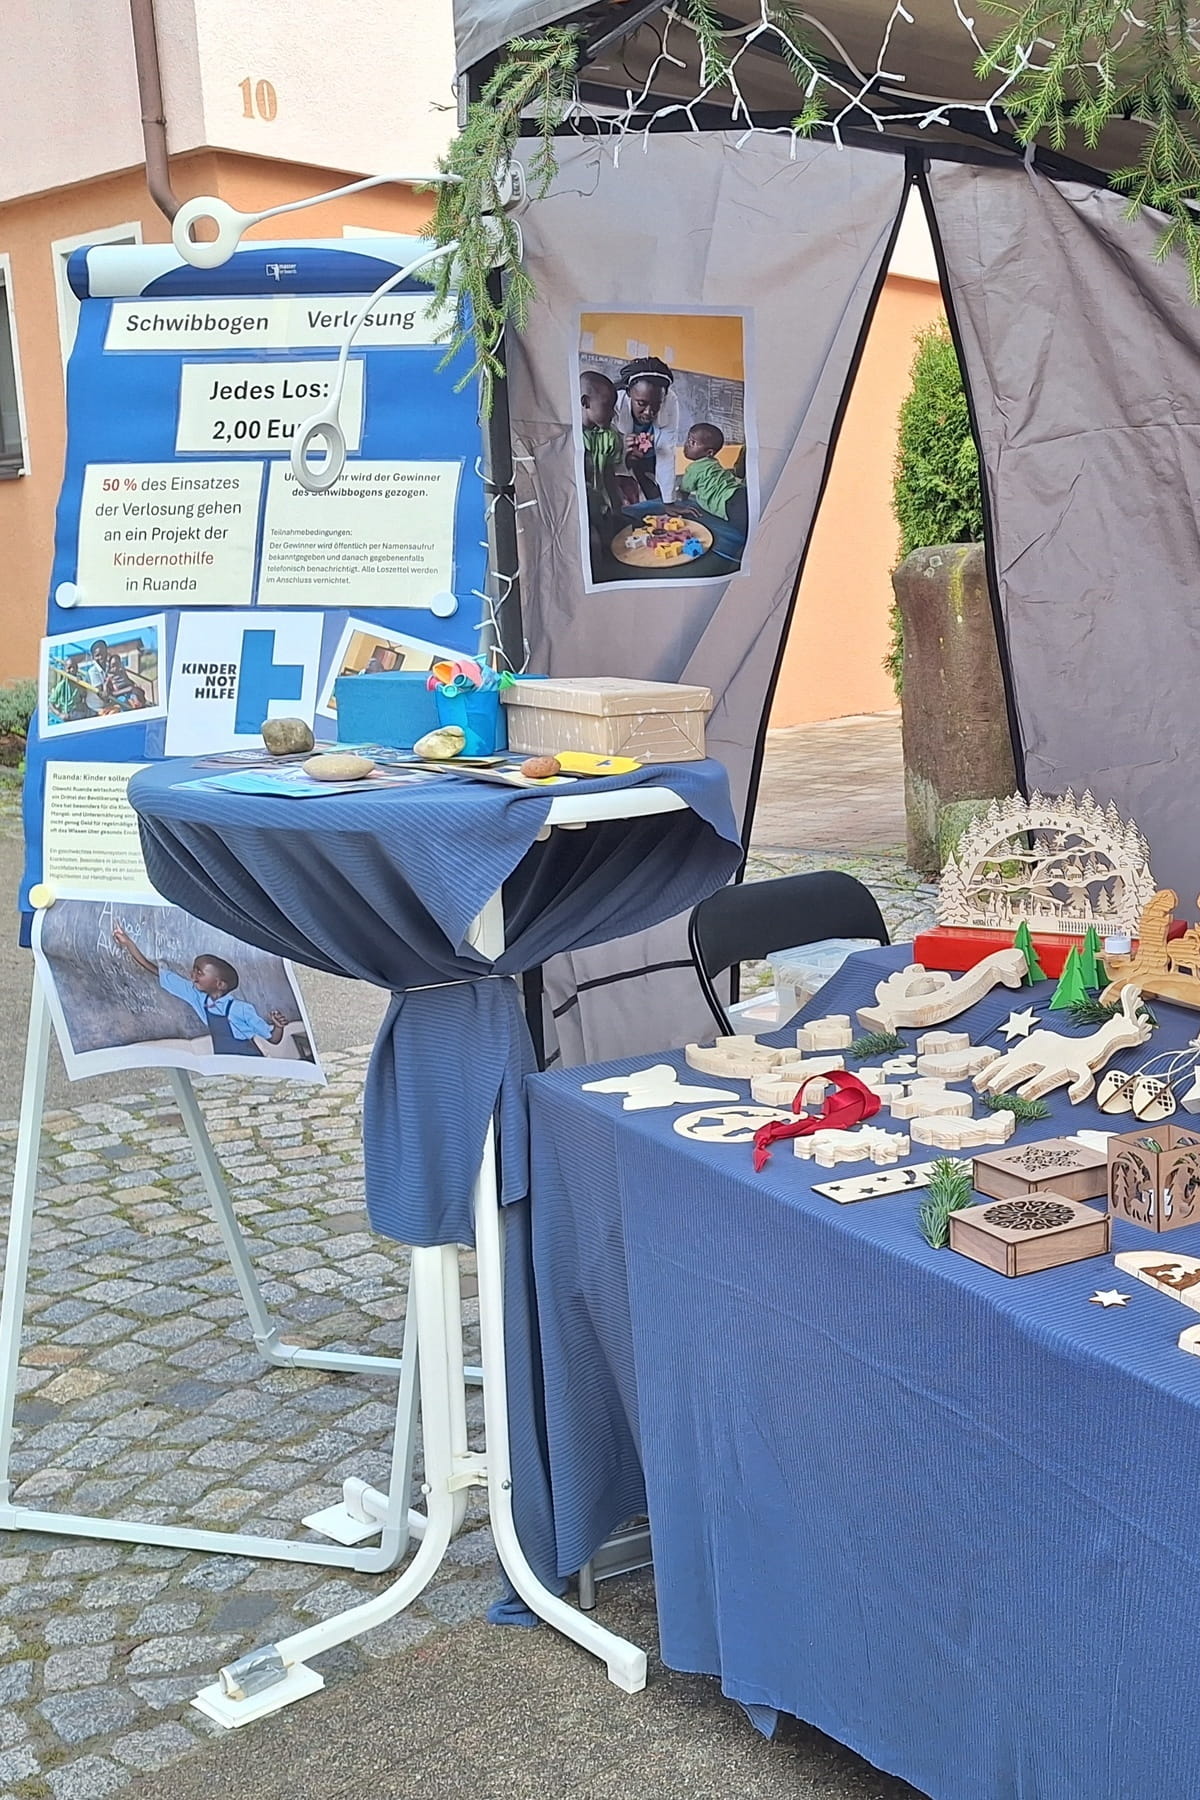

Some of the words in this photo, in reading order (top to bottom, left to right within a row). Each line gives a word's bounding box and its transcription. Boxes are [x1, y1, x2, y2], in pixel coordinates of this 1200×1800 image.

[238, 77, 277, 121] 10
[126, 315, 269, 334] Schwibbogen
[209, 381, 275, 400] Jedes
[282, 380, 329, 398] Los:
[212, 421, 261, 443] 2,00
[267, 419, 319, 438] Eu
[351, 472, 372, 481] wird
[374, 472, 390, 481] der
[392, 473, 441, 482] Gewinner
[102, 479, 120, 491] 50
[124, 478, 138, 491] %
[141, 478, 167, 491] des
[171, 477, 240, 491] Einsatzes
[291, 488, 309, 496] des
[385, 490, 428, 499] gezogen.
[95, 504, 119, 517] der
[122, 502, 194, 518] Verlosung
[197, 501, 242, 518] gehen
[104, 529, 121, 541] an
[125, 528, 147, 541] ein
[151, 526, 201, 543] Projekt
[204, 526, 228, 540] der
[271, 528, 353, 537] Teilnahmebedingungen:
[269, 542, 282, 550] Der
[283, 542, 316, 550] Gewinner
[317, 542, 333, 550] wird
[113, 551, 214, 567] Kindernothilfe
[268, 553, 326, 562] bekanntgegeben
[369, 554, 425, 562] gegebenenfalls
[267, 565, 305, 573] telefonisch
[306, 565, 360, 574] benachrichtigt.
[126, 577, 138, 591] in
[142, 577, 197, 591] Ruanda
[182, 663, 237, 675] KINDER
[205, 675, 236, 687] NOT
[195, 687, 235, 699] HILFE
